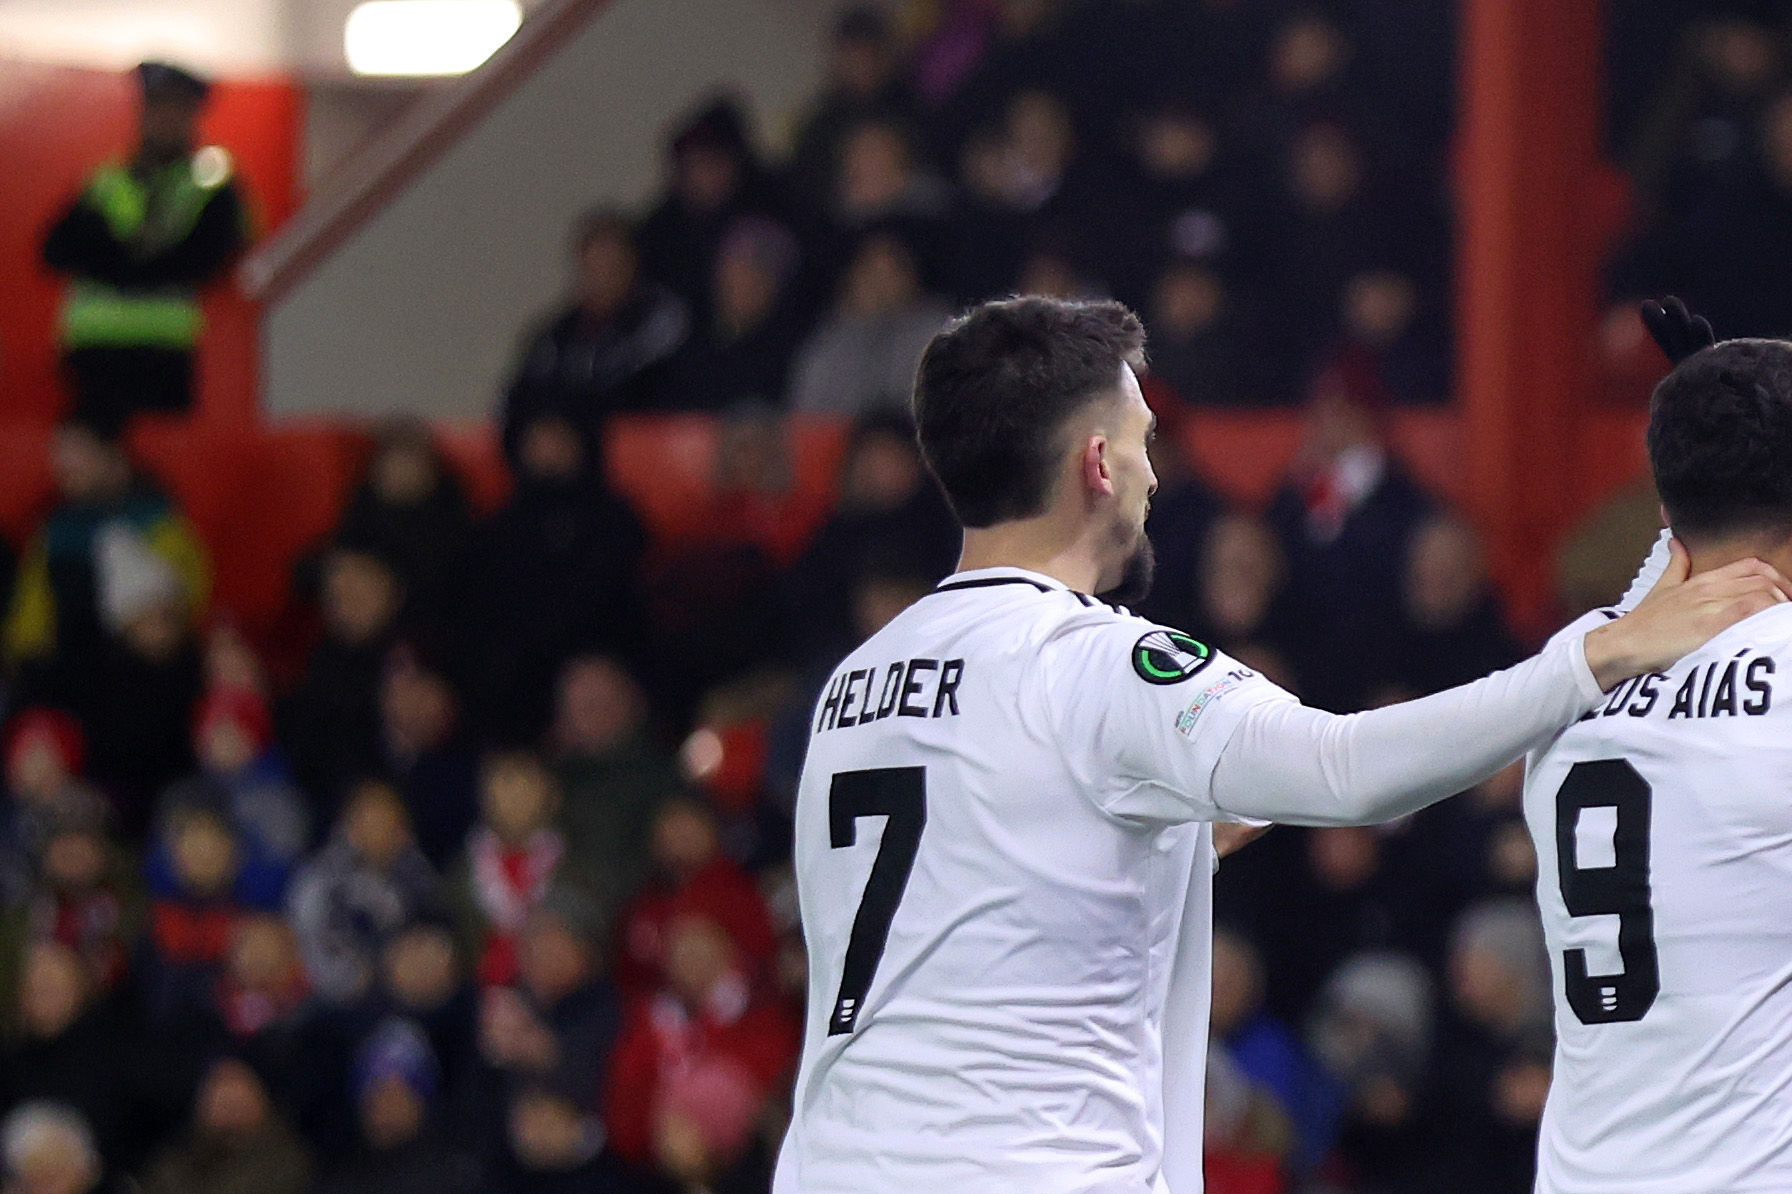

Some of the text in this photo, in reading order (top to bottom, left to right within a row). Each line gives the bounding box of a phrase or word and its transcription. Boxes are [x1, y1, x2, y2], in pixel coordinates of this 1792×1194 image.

[816, 657, 966, 734] HELDER
[1667, 647, 1776, 719] AIÁS
[827, 764, 928, 1037] 7
[1556, 757, 1660, 1025] 9
